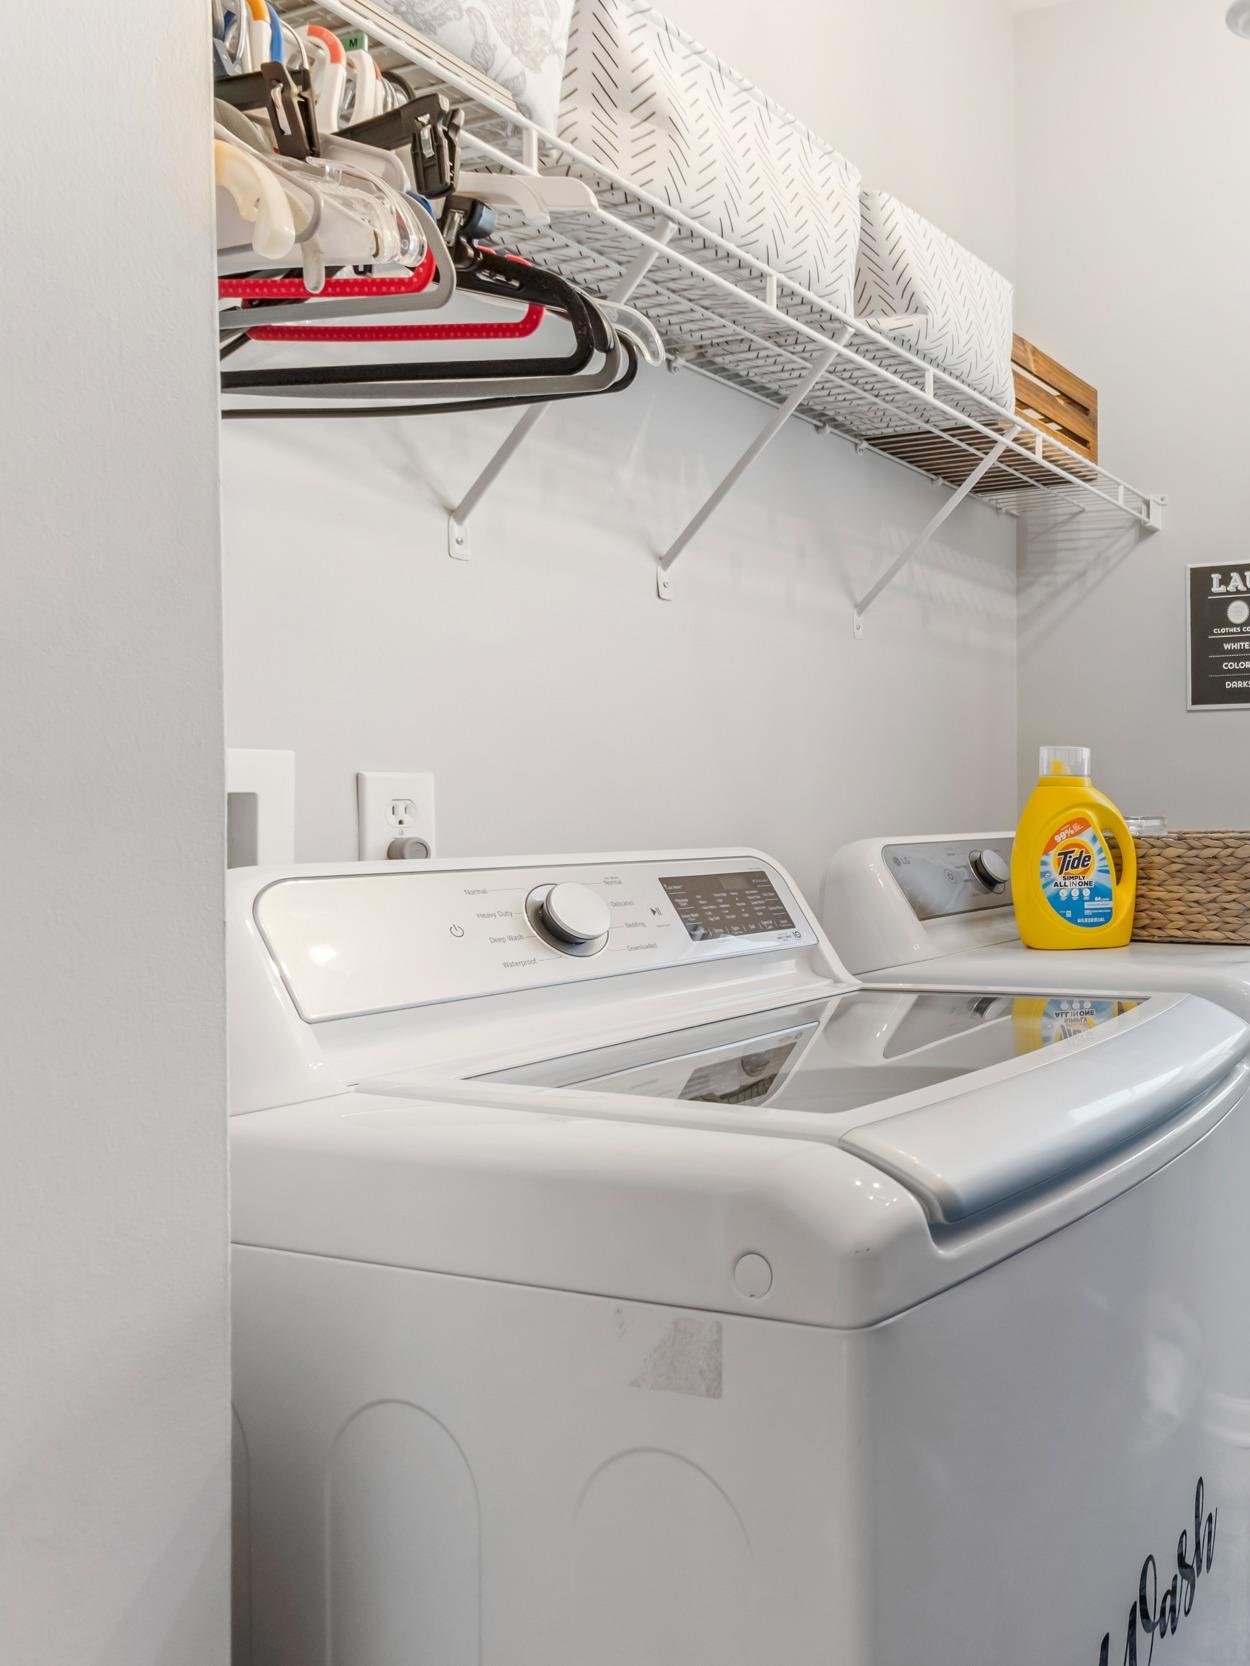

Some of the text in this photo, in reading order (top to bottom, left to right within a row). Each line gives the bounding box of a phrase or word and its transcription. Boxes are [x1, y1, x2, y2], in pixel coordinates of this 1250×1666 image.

[349, 38, 358, 48] M
[1054, 826, 1074, 843] 99%
[900, 856, 911, 865] LG
[1057, 849, 1092, 876] Tide
[463, 887, 488, 896] Normal
[476, 910, 513, 920] Heavy Duty
[488, 936, 507, 944] Deep
[502, 958, 537, 968] Waterproof
